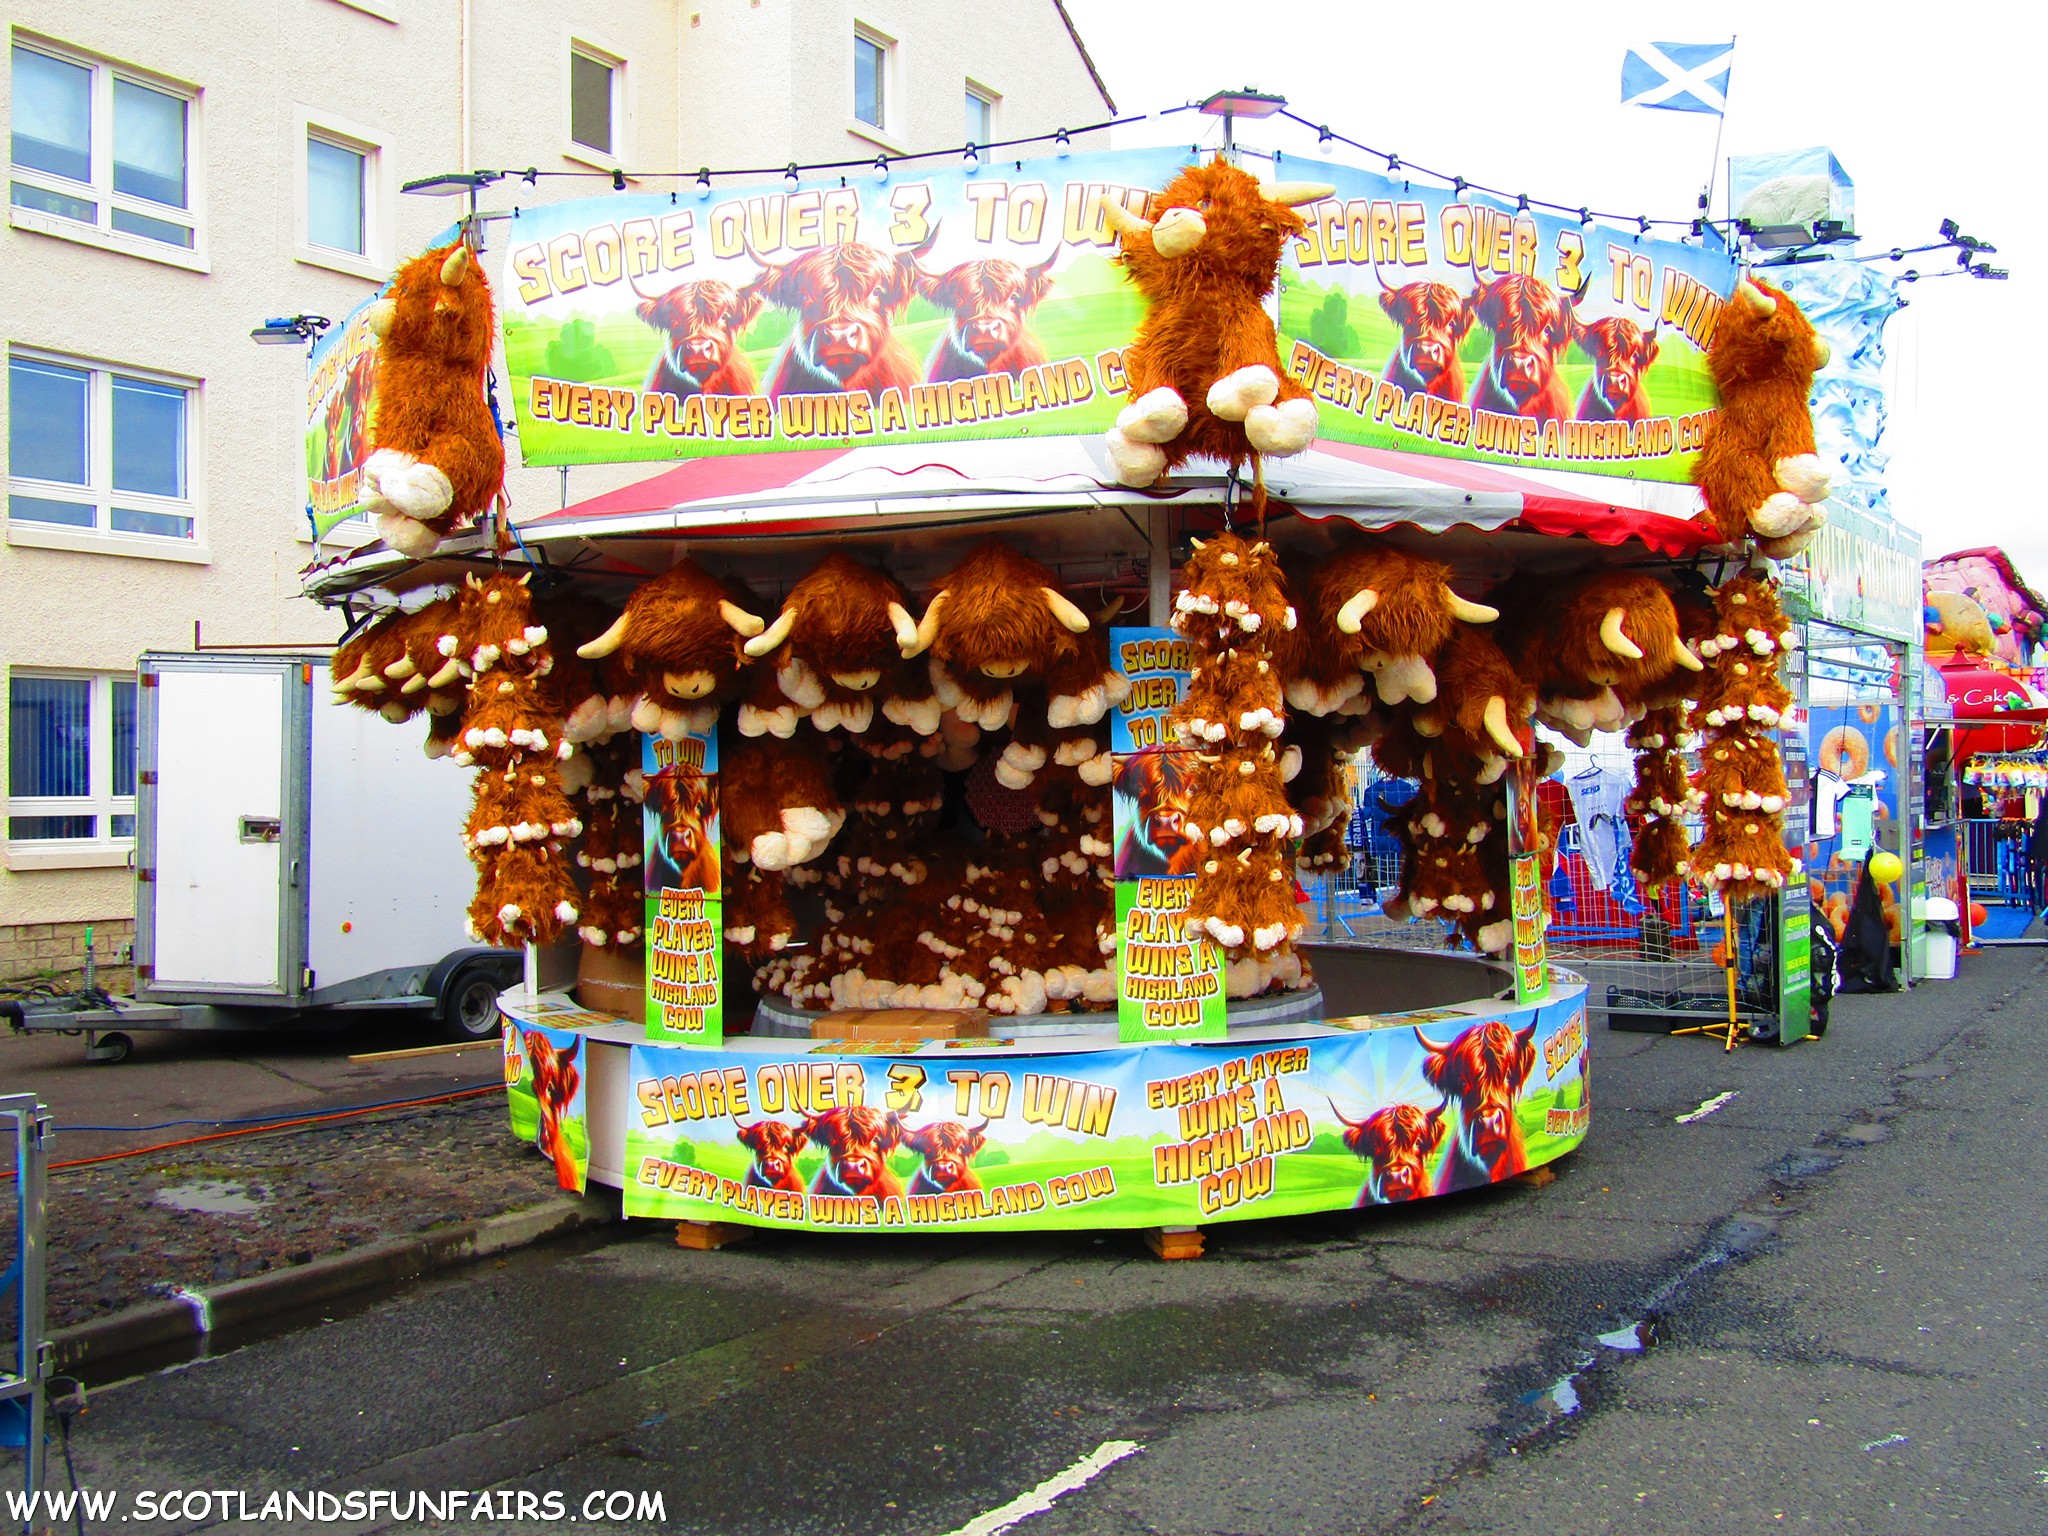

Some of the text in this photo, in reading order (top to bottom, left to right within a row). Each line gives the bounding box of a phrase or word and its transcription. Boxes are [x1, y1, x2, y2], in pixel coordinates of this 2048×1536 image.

[514, 182, 1160, 305] SCORE OVER 3 TO WI
[1293, 199, 1725, 353] SCORE OVER 3 TO WIN
[531, 380, 633, 429] EVERY
[644, 394, 771, 440] PLAYER
[780, 395, 871, 437] WINS
[882, 393, 904, 430] A
[917, 359, 1093, 427] HIGHLAND
[1290, 342, 1373, 415] EVERY
[1374, 382, 1471, 446] PLAYER
[1474, 413, 1536, 457] WINS
[1542, 419, 1559, 458] A
[1564, 418, 1673, 460] HIGHLAND
[1121, 640, 1194, 674] SCOR
[1128, 716, 1157, 749] TO
[653, 737, 706, 769] TO WIN
[661, 887, 704, 919] EVERY
[1139, 878, 1197, 909] EVERY
[654, 917, 715, 953] PLAYER
[1127, 910, 1201, 943] PLAY
[653, 948, 717, 984] WINS A
[1126, 941, 1218, 977] WINS A
[651, 978, 717, 1006] HIGHLAND
[1125, 973, 1218, 1001] HIGHLAND
[664, 1004, 704, 1031] COW
[1144, 1000, 1201, 1027] COW
[1543, 1008, 1582, 1082] SCORE
[1147, 1046, 1310, 1110] EVERY PLAYER
[637, 1062, 1118, 1138] SCORE OVER 3 TO WIN
[1178, 1077, 1285, 1144] WINS A
[1154, 1109, 1313, 1185] HIGHLAND
[638, 1158, 1118, 1226] EVERY PLAYER WINS A HIGHLAND COW
[1200, 1157, 1276, 1216] COW
